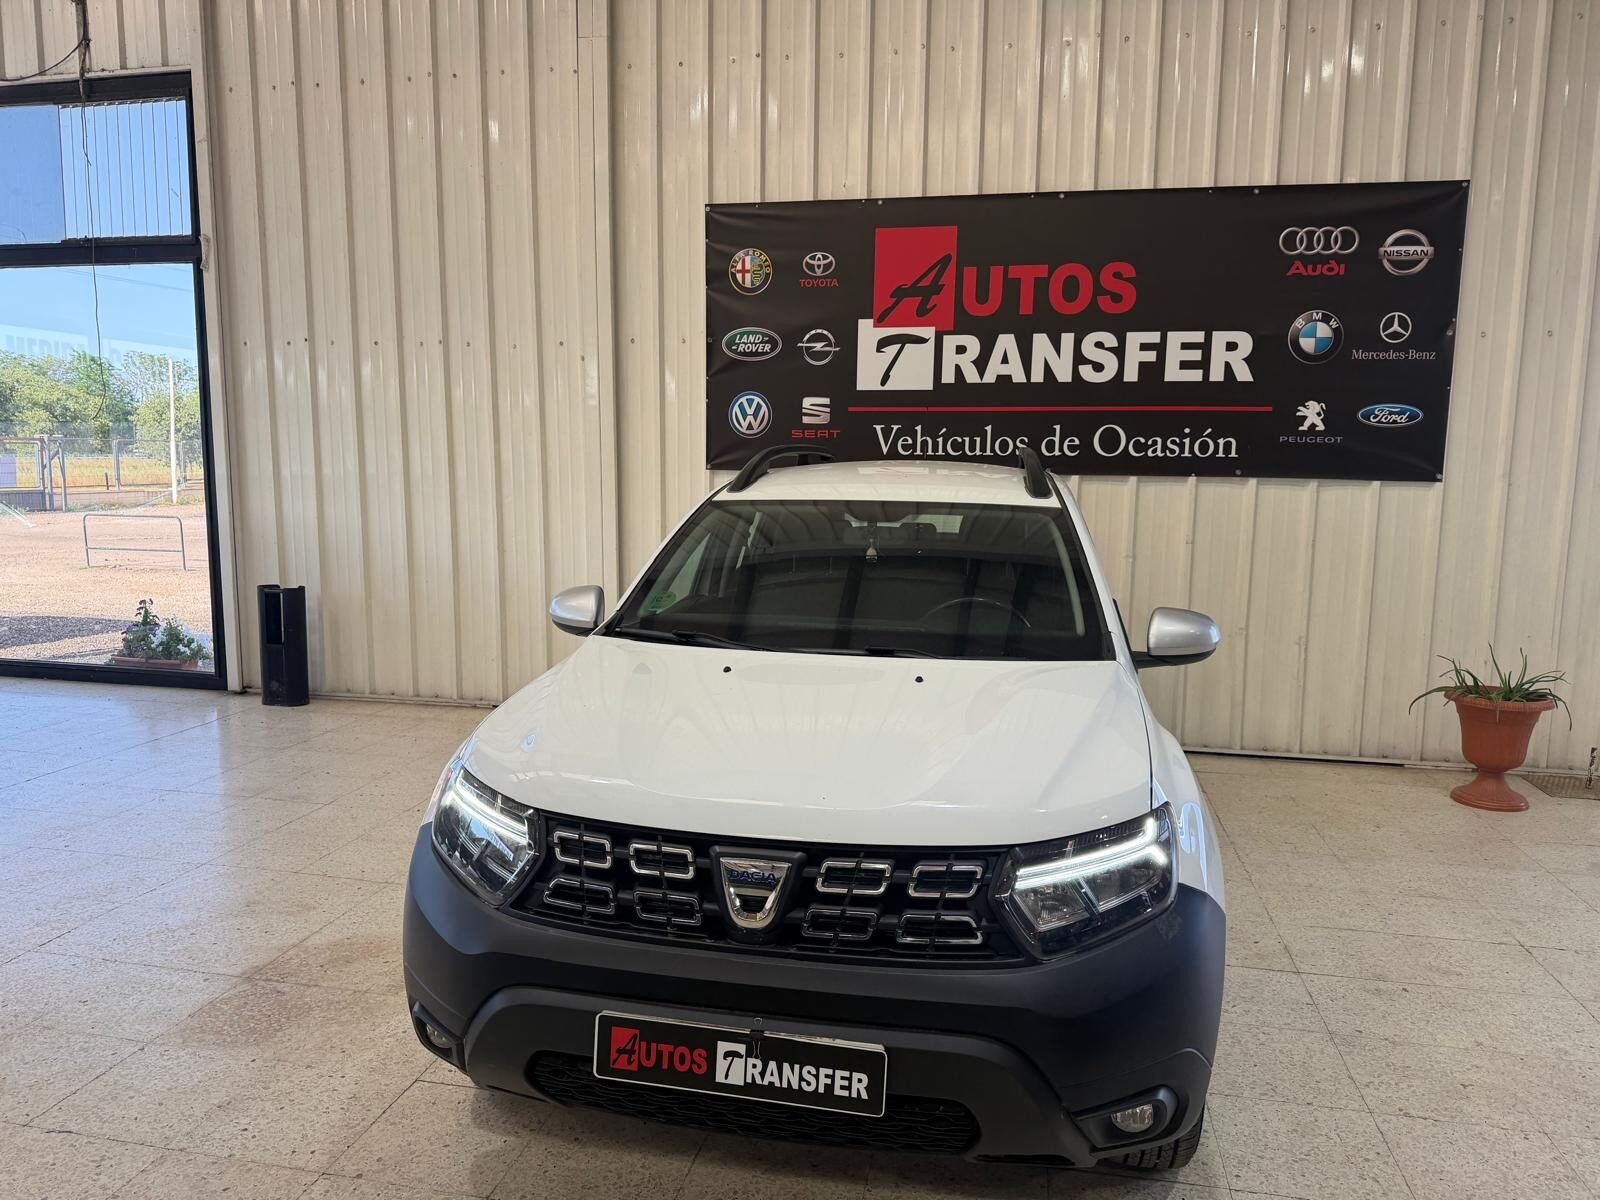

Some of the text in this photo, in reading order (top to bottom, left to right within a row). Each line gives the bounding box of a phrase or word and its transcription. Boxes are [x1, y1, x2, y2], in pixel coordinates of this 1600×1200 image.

[1383, 248, 1429, 257] NISSAN
[749, 250, 771, 273] ROMEO
[1286, 260, 1346, 276] Audi
[800, 279, 839, 287] TOYOTA
[877, 253, 1137, 323] AUTOS
[1296, 311, 1340, 329] BMW
[876, 331, 1254, 387] TRANSFER
[1351, 350, 1436, 360] Mercedes-Benz
[1369, 406, 1411, 423] Ford
[791, 430, 840, 438] SEAT
[873, 424, 1239, 457] Vehículos de Ocasión
[729, 870, 776, 880] DACIA
[612, 1033, 869, 1100] AUTOS TRANSFER
